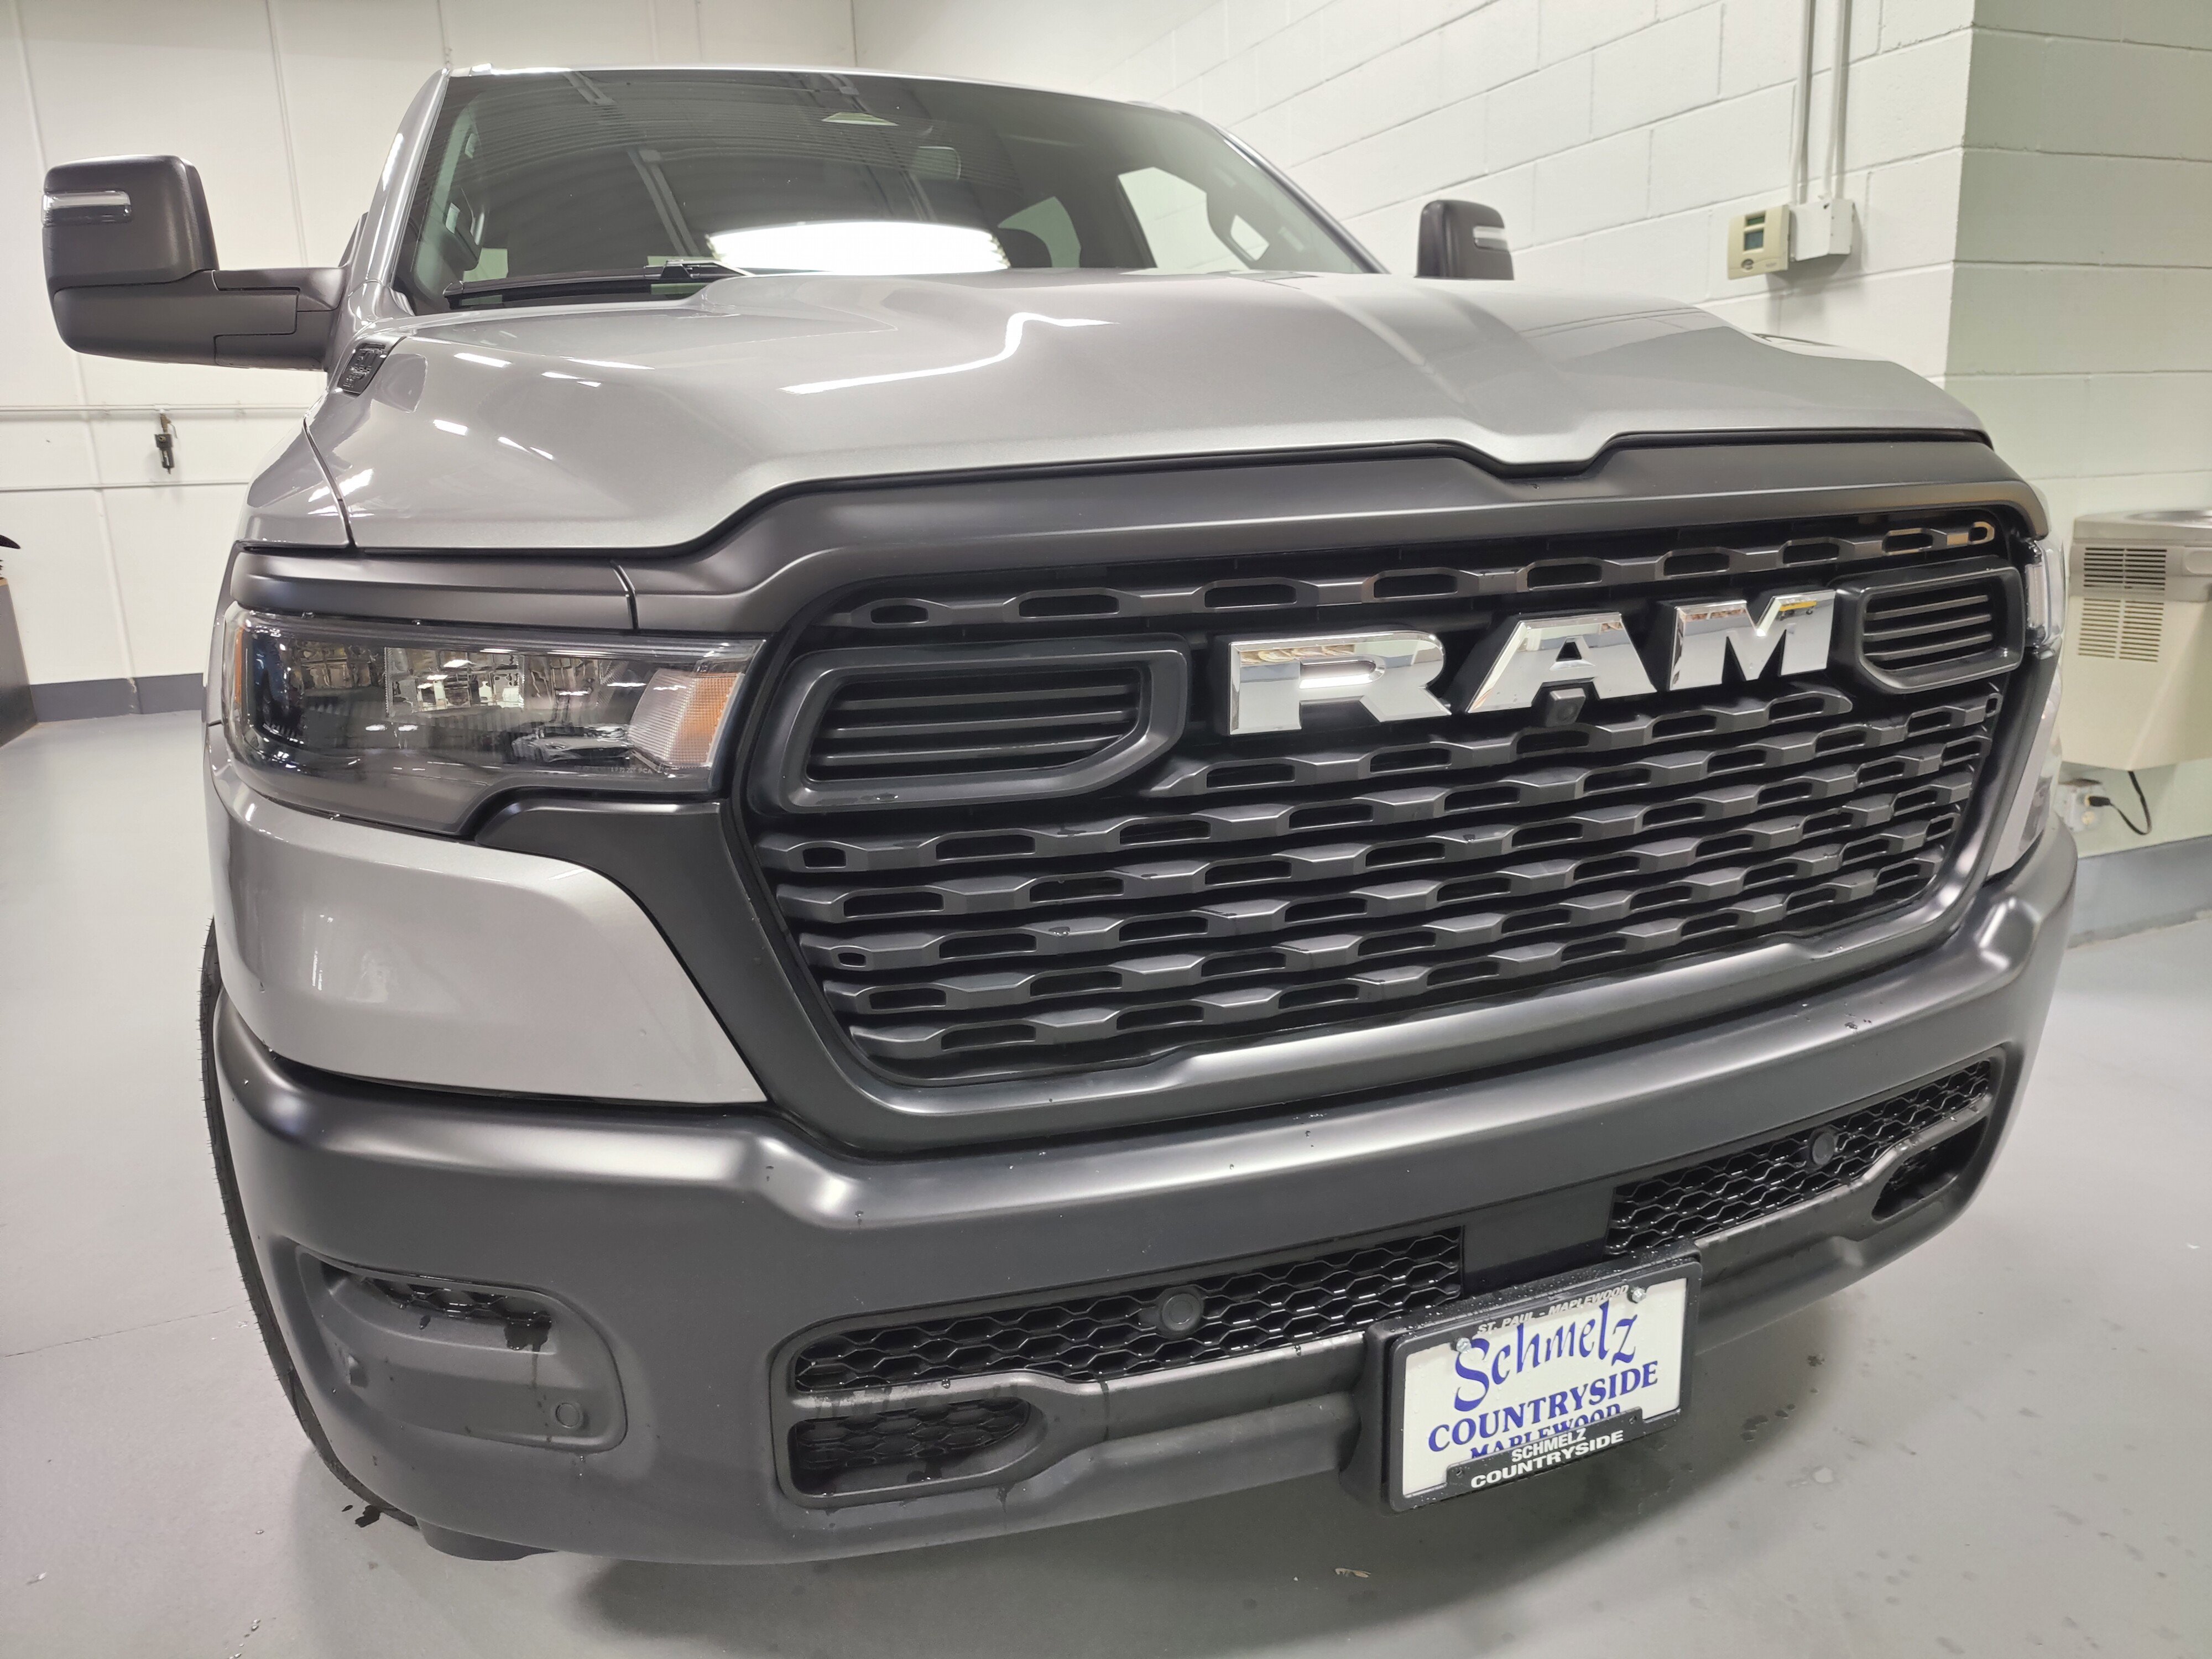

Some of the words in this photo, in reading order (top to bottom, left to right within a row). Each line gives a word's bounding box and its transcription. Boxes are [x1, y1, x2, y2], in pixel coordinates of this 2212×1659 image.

[1230, 589, 1836, 735] RAM
[1477, 1321, 1498, 1334] ST.
[1501, 1311, 1535, 1328] PAUL
[1548, 1284, 1629, 1315] MAPLEWOOD
[1453, 1300, 1637, 1412] Schmelz
[1428, 1360, 1658, 1452] COUNTRYSIDE
[1470, 1430, 1624, 1484] COUNTRYSIDE
[1511, 1427, 1587, 1463] SCHMELZ
